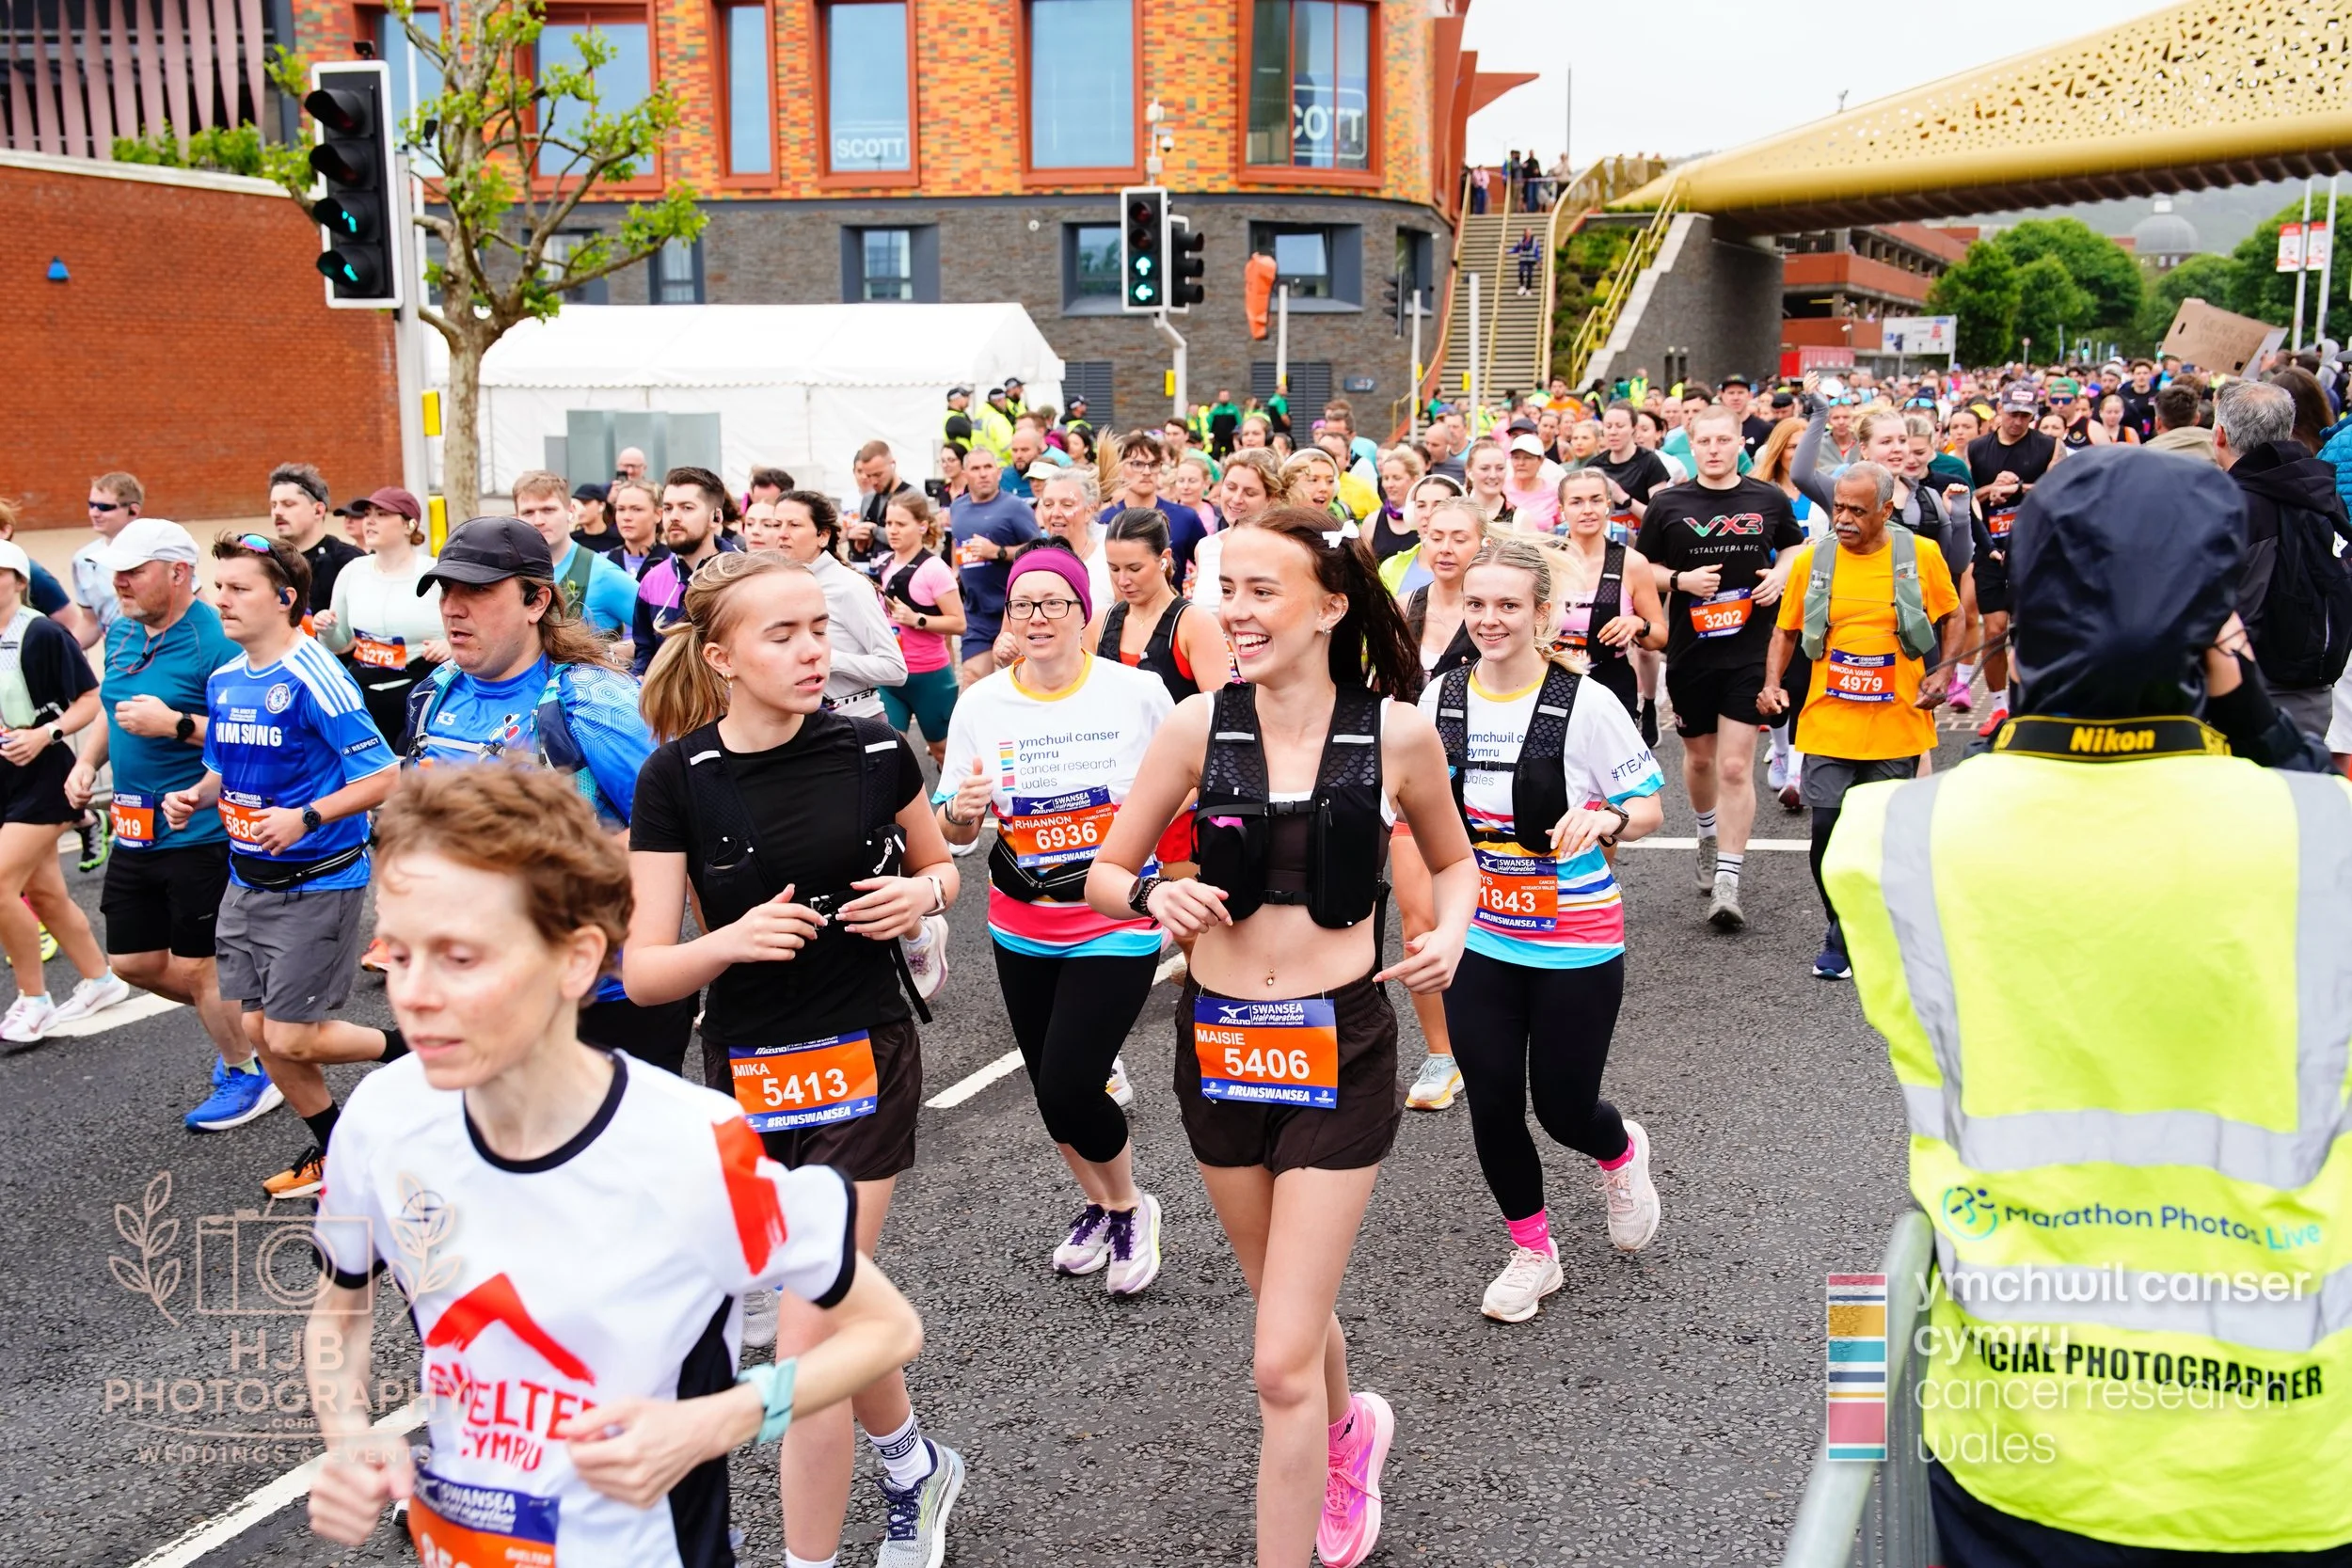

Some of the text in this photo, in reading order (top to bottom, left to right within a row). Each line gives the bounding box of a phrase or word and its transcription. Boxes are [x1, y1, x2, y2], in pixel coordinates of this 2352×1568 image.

[836, 137, 904, 159] SCOTT
[1683, 513, 1764, 537] VX3
[1689, 545, 1740, 555] YSTALYFERA
[1704, 610, 1742, 629] 3202
[1839, 674, 1883, 692] 4979
[352, 737, 379, 752] RESPECT
[1019, 731, 1120, 751] ymchwil canser
[2070, 726, 2155, 752] Nikon
[1020, 750, 1059, 763] cymru
[1020, 757, 1117, 776] cancer research
[1022, 777, 1057, 790] wales
[1054, 792, 1089, 805] SWANSEA
[1015, 816, 1072, 830] RHIANNON
[1036, 822, 1098, 849] 6936
[1481, 875, 1493, 885] YS
[1480, 886, 1535, 912] 1843
[1479, 911, 1536, 927] #RUNSWANSEA
[1252, 1003, 1303, 1014] SWANSEA
[1269, 1013, 1304, 1022] Marathon
[1196, 1029, 1246, 1046] MAISIE
[733, 1063, 770, 1077] MIKA
[1224, 1048, 1310, 1080] 5406
[763, 1069, 848, 1106] 5413
[1227, 1085, 1311, 1102] #RUNSWANSEA
[767, 1106, 851, 1128] #RUNSWANSEA
[2005, 1202, 2322, 1251] Marathon Photos Live
[2065, 1342, 2323, 1402] PHOTOGRAPHER
[441, 1481, 516, 1513] SWANSEA
